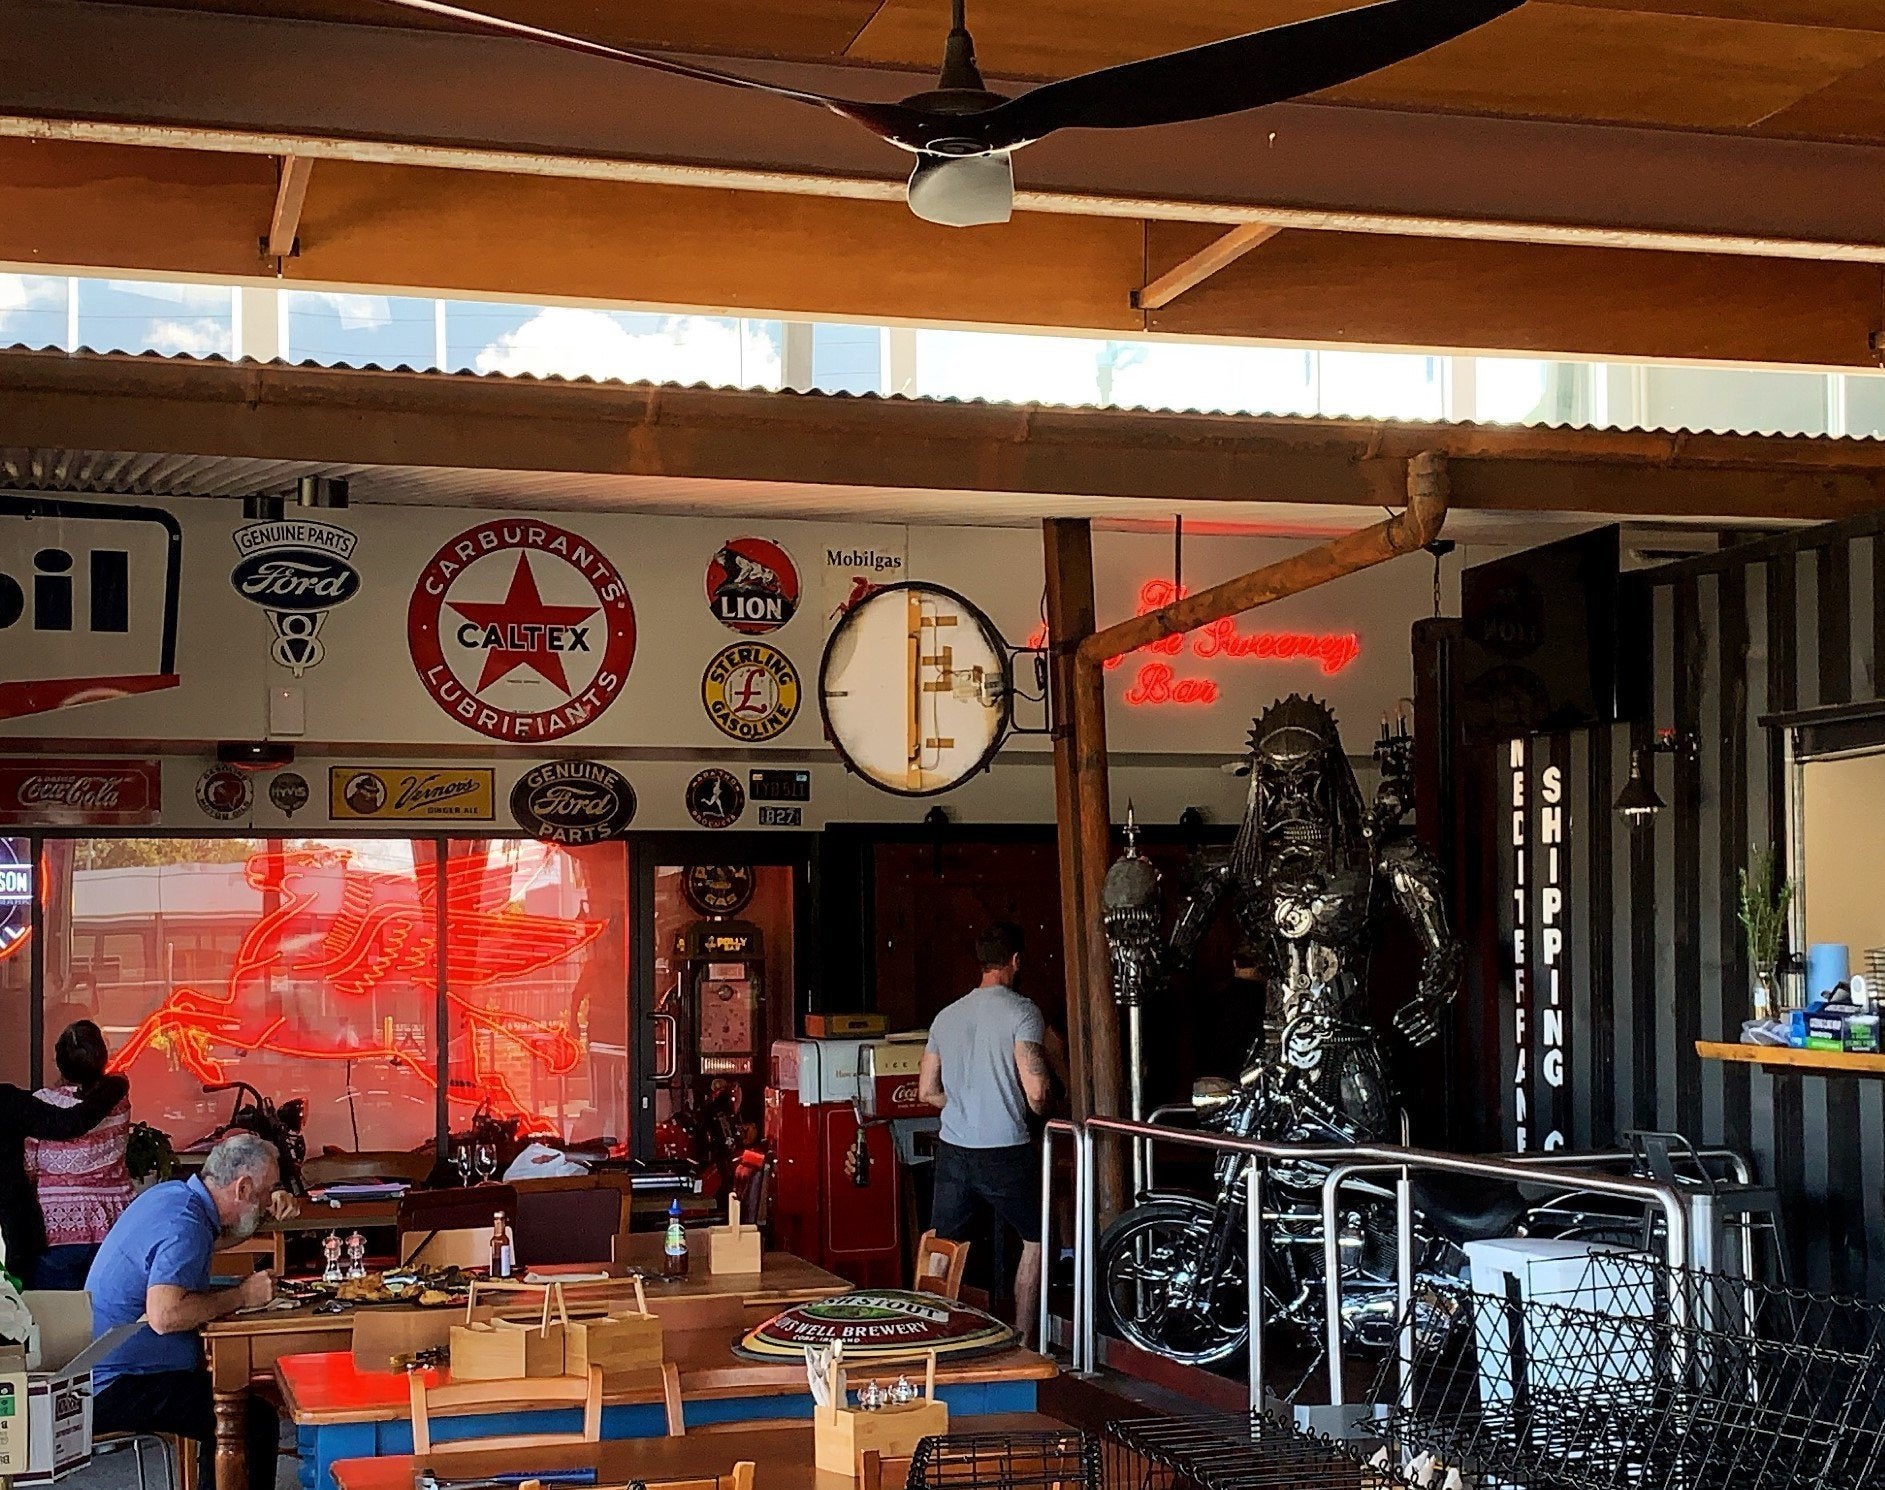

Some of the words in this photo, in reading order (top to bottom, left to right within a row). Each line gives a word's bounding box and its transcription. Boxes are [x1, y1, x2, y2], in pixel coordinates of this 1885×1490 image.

[240, 525, 305, 549] GENUINE
[308, 527, 351, 552] PARTS
[425, 526, 623, 602] CARBURANTS
[827, 549, 903, 572] Mobilgas
[241, 561, 351, 597] Ford
[721, 596, 783, 620] LION
[456, 622, 591, 652] CALTEX
[711, 648, 793, 687] STERLING
[1127, 662, 1217, 705] Bar
[427, 665, 618, 736] LUBRIFIANTS
[711, 700, 792, 739] GASOLINE
[527, 761, 621, 790] GENUINE
[533, 785, 613, 817] Ford
[538, 821, 613, 844] PARTS
[1542, 765, 1564, 1088] SHIPPING
[856, 1297, 939, 1318] STOUT
[794, 1322, 836, 1337] WELL
[842, 1321, 929, 1337] BREWERY
